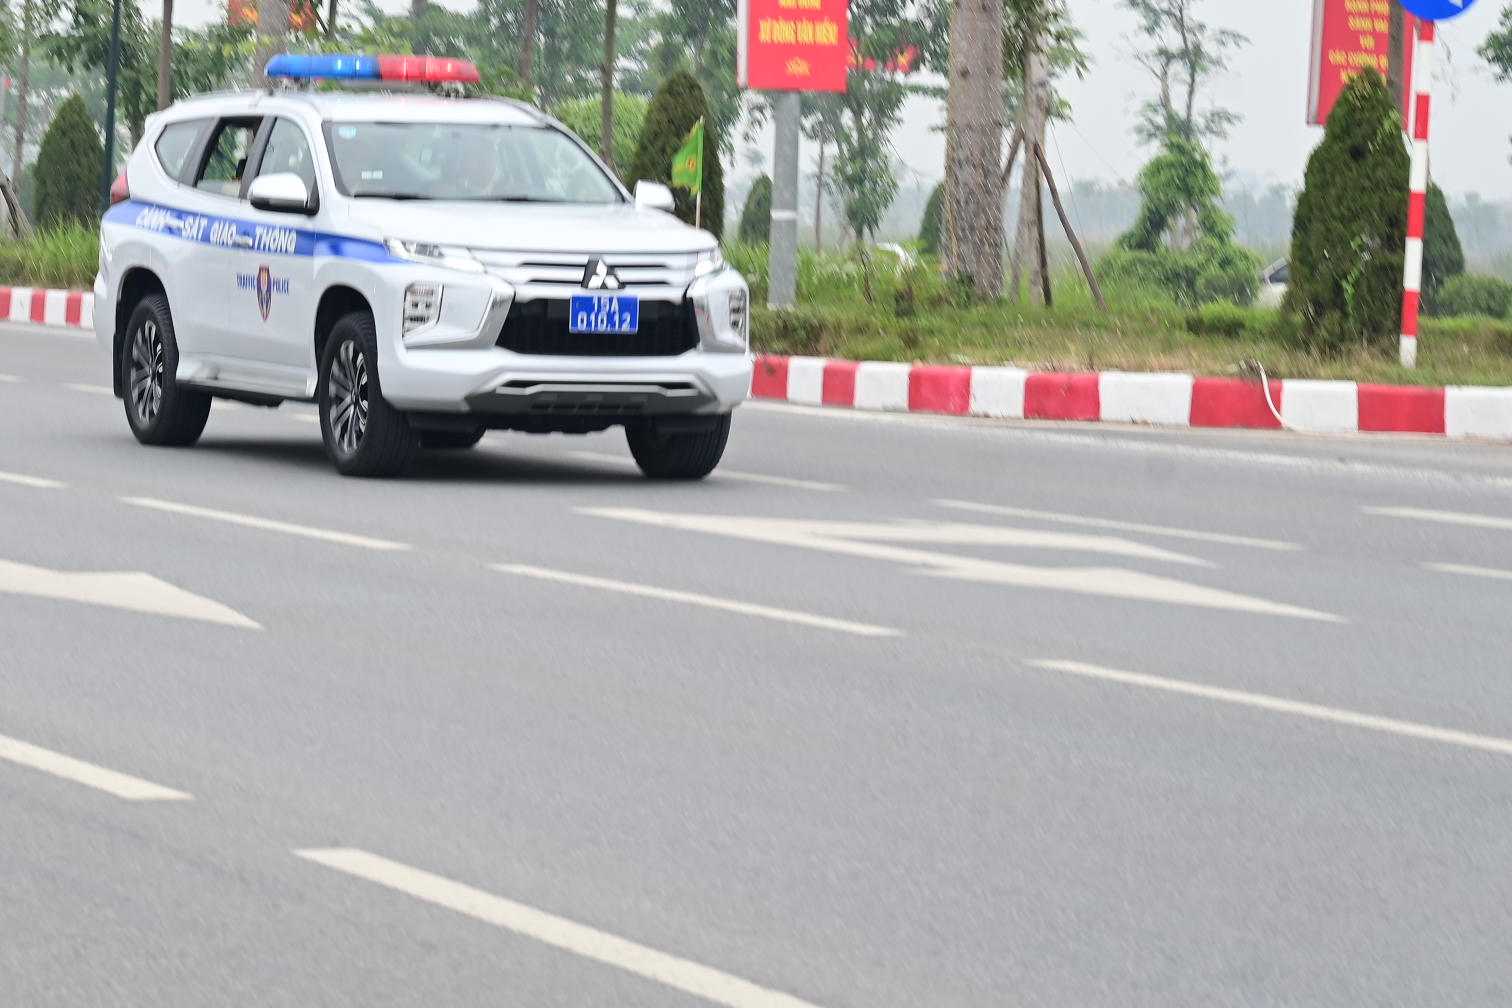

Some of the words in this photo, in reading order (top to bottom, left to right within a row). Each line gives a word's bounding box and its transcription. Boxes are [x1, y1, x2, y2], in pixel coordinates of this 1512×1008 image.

[182, 212, 208, 241] SÁT
[210, 218, 236, 246] GIAO
[254, 223, 297, 253] THÔNG
[272, 277, 290, 295] POLICE
[579, 312, 630, 331] 010.12
